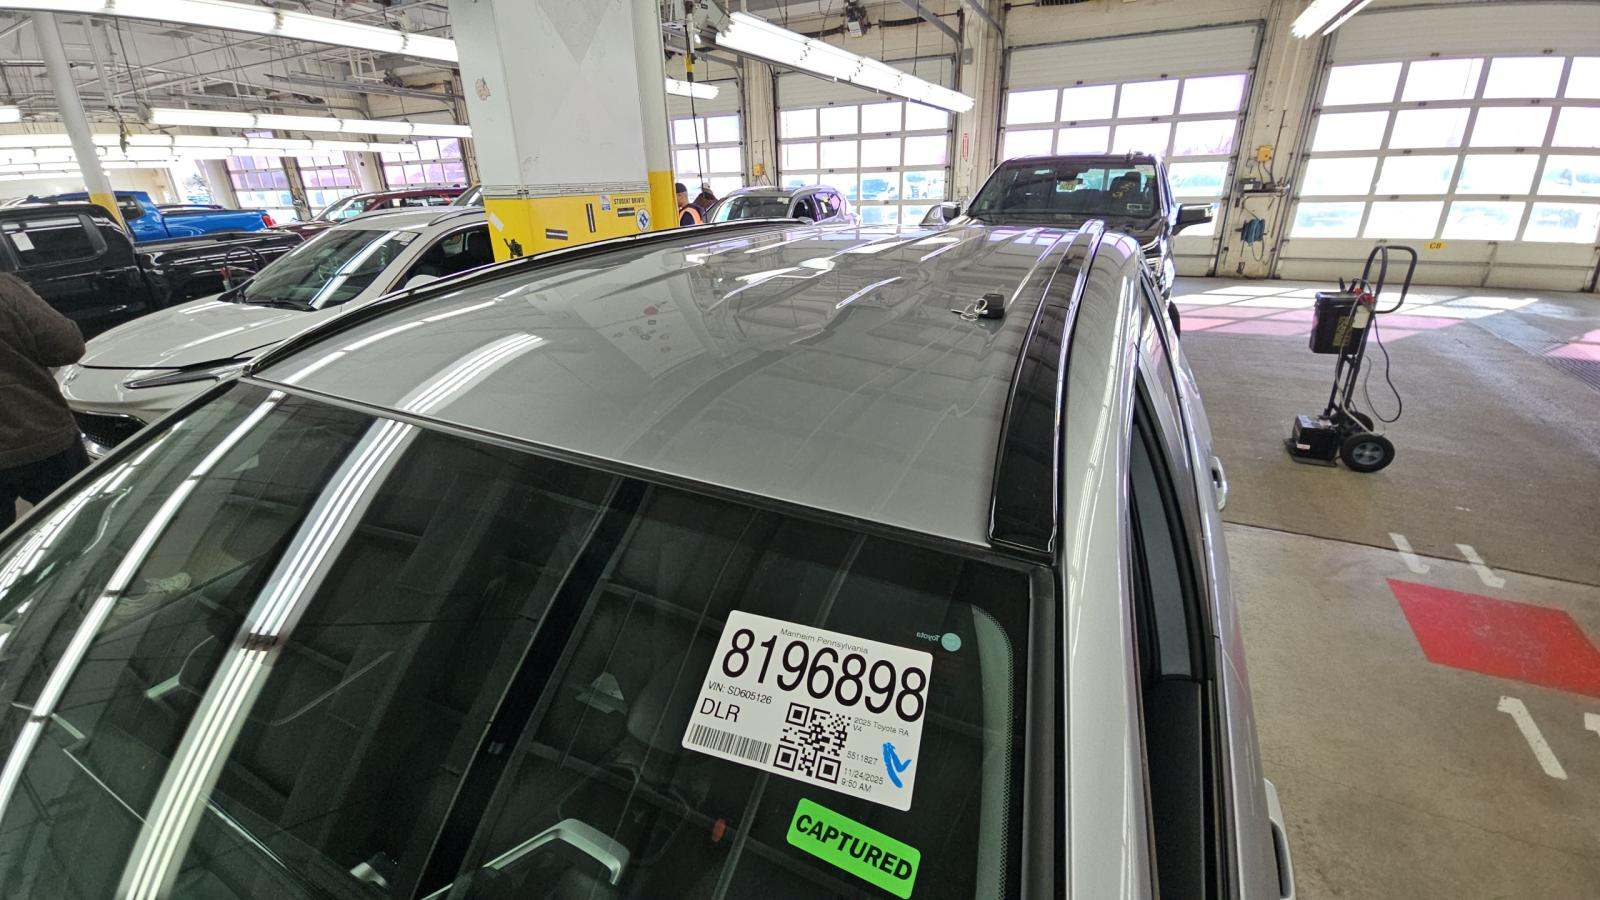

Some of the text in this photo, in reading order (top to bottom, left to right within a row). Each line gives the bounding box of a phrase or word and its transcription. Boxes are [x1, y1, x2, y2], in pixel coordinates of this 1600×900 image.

[781, 628, 868, 654] Manheim Pennsylvania
[722, 628, 927, 722] 8196898
[708, 681, 772, 704] VIN: SD605126
[700, 697, 740, 722] DLR
[853, 724, 862, 732] V4
[854, 717, 909, 736] 2025 Toyota RA
[841, 778, 872, 792] 9:50 AM
[844, 768, 884, 784] 11/24/2025
[795, 814, 913, 880] CAPTURED
